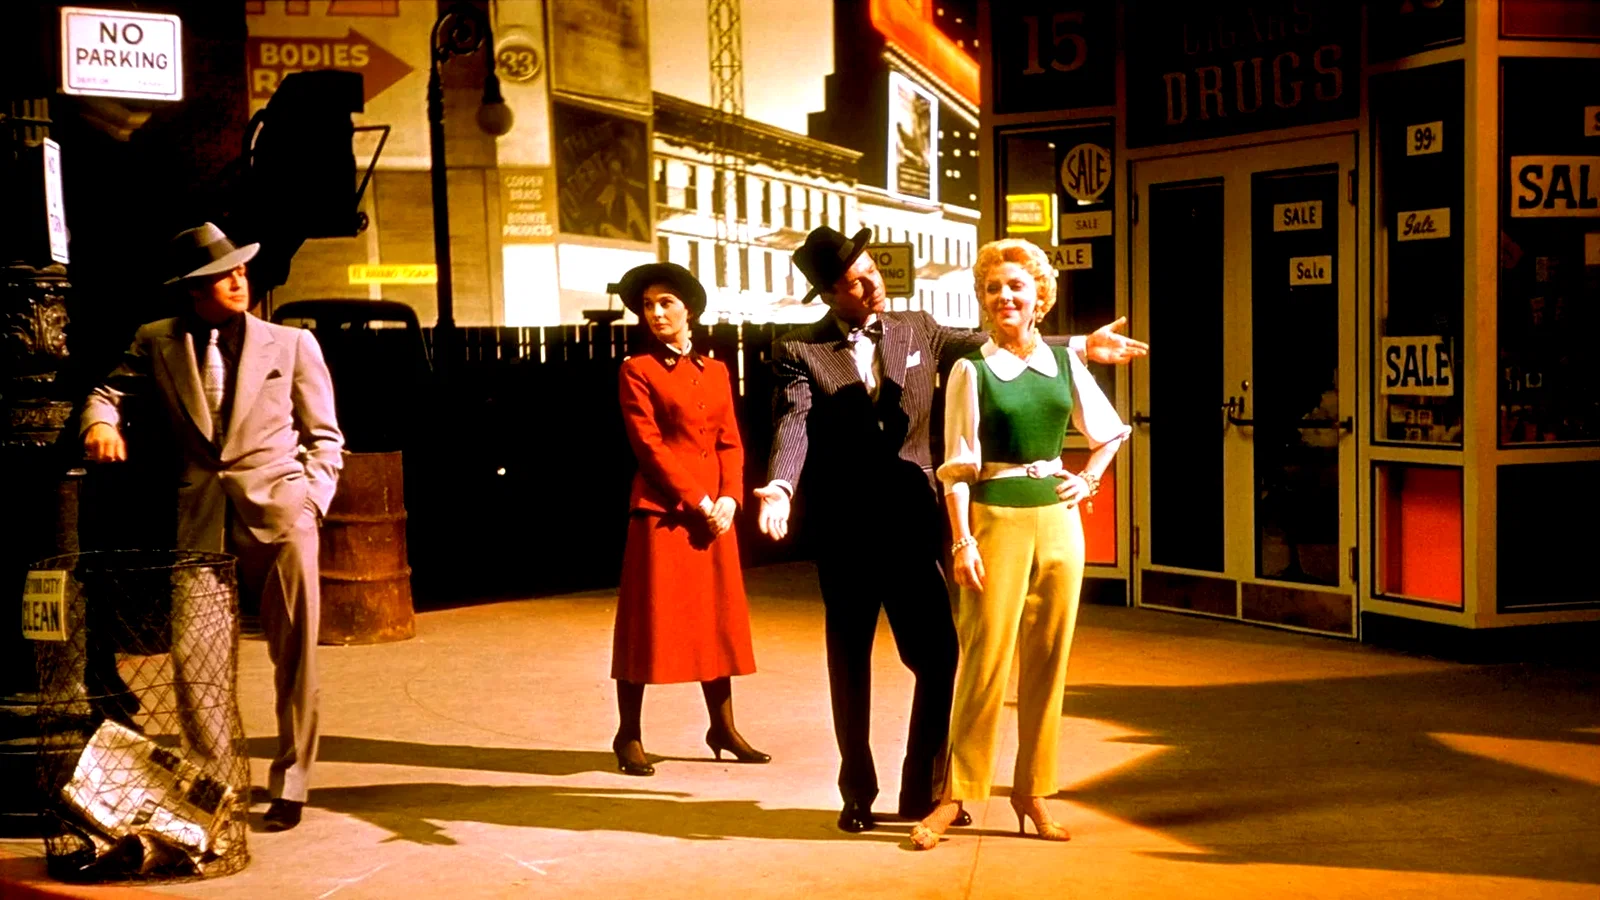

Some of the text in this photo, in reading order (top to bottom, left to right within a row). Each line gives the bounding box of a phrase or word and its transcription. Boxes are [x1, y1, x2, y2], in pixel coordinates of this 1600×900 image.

[99, 21, 143, 45] NO
[1021, 11, 1088, 75] 15
[76, 47, 167, 70] PARKING
[259, 43, 369, 67] BODIES
[501, 51, 534, 75] 33
[1163, 43, 1344, 126] DRUGS
[1067, 148, 1107, 195] SALE
[1075, 219, 1099, 230] SALE
[1283, 206, 1317, 226] SALE
[1403, 213, 1437, 236] Sale
[1045, 248, 1084, 265] SALE
[1296, 261, 1324, 280] Sale
[1386, 343, 1450, 388] SALE
